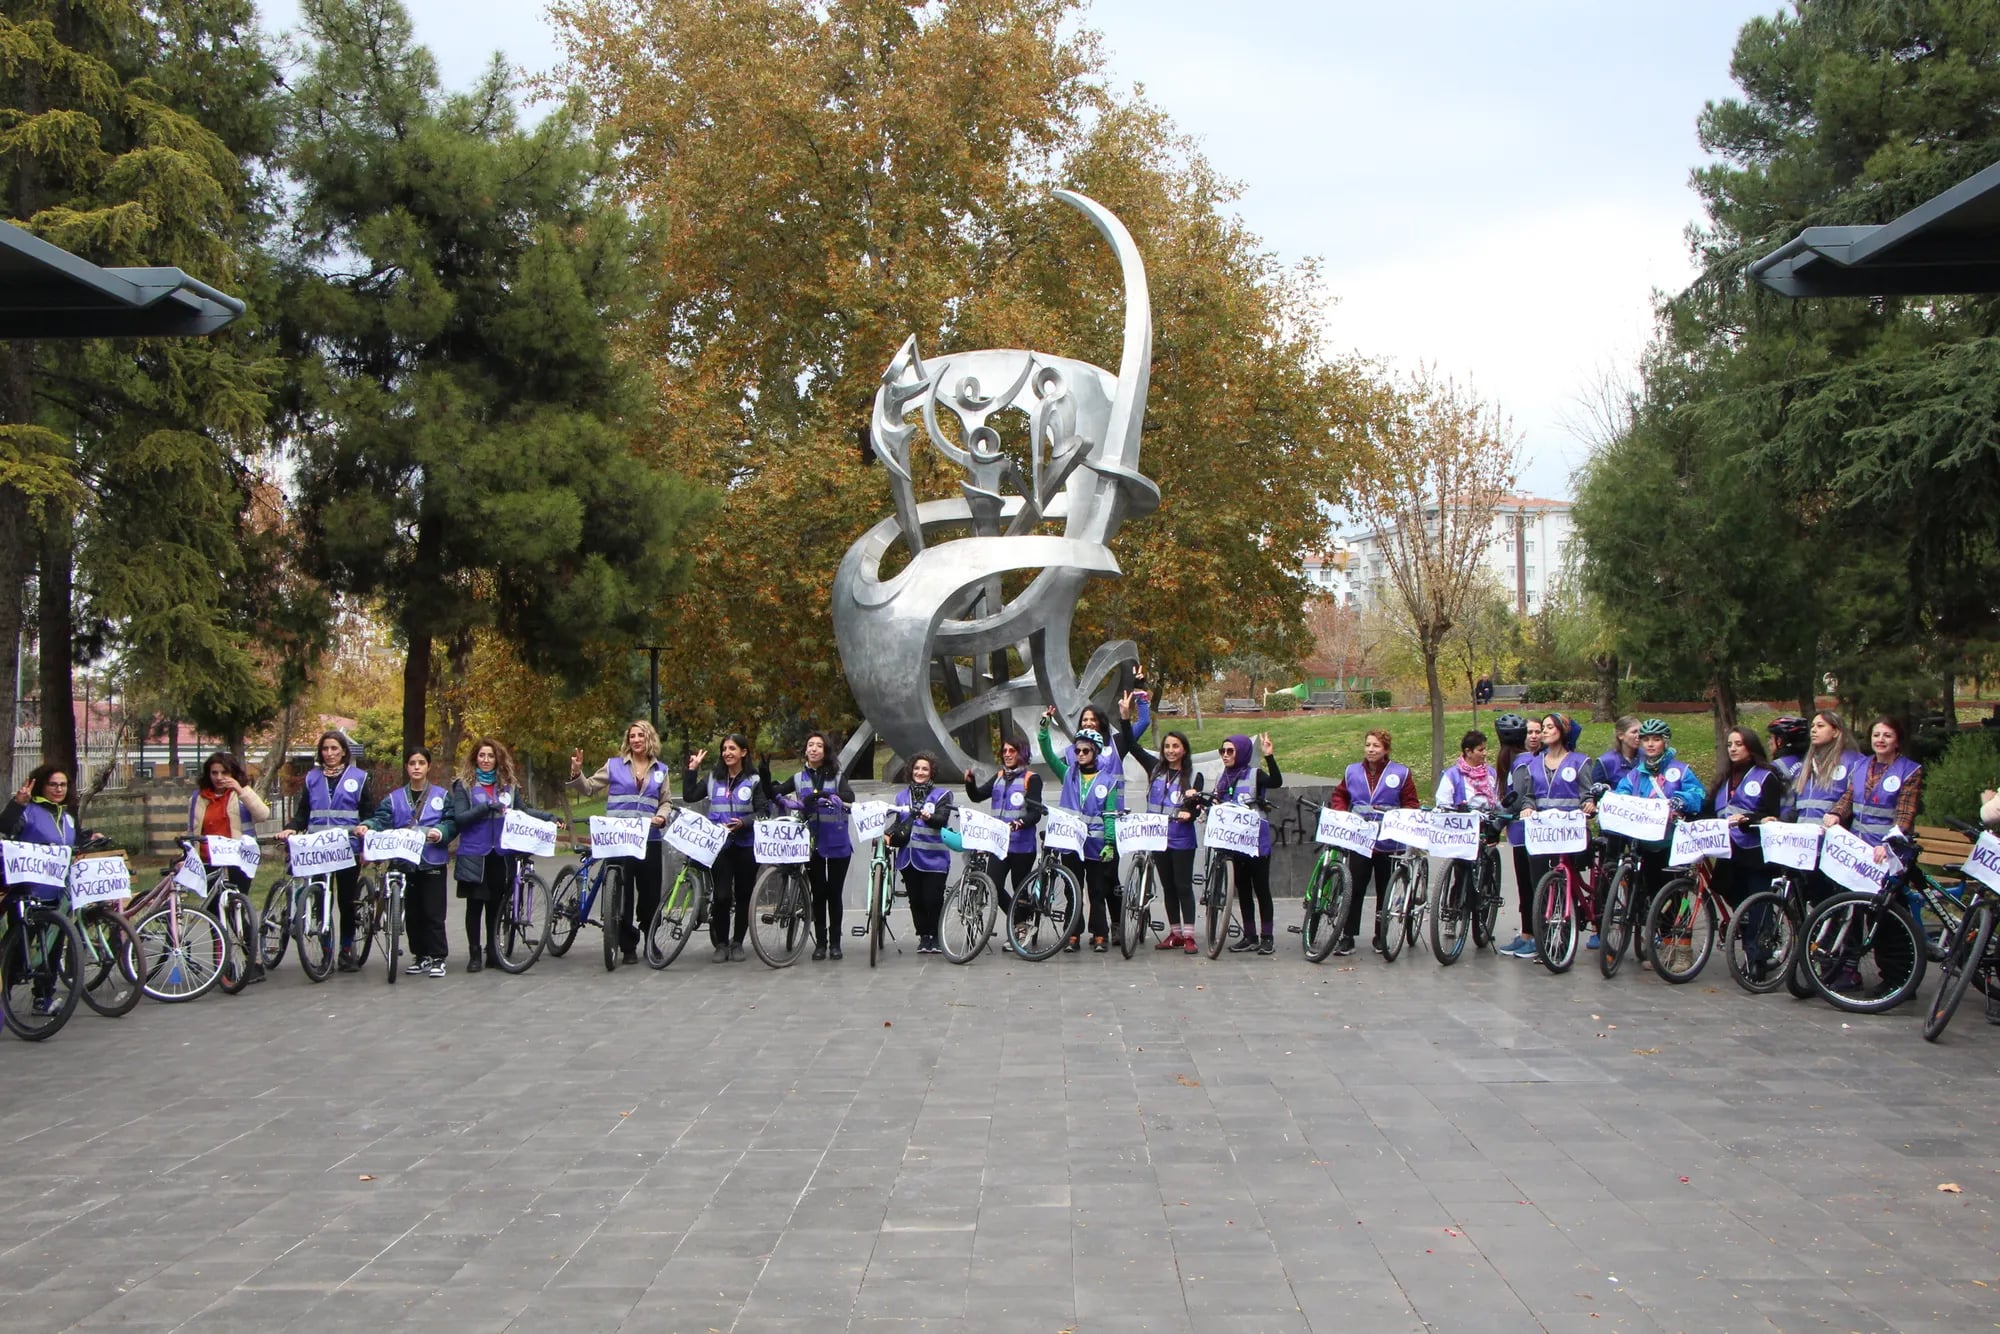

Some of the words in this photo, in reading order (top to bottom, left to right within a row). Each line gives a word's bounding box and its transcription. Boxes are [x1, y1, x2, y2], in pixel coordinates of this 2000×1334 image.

[690, 816, 727, 843] ASLA
[1444, 816, 1474, 830] ASLA
[1690, 820, 1721, 833] ASLA
[312, 830, 348, 847] ASLA
[773, 824, 805, 841] ASLA
[97, 860, 128, 876] ASLA
